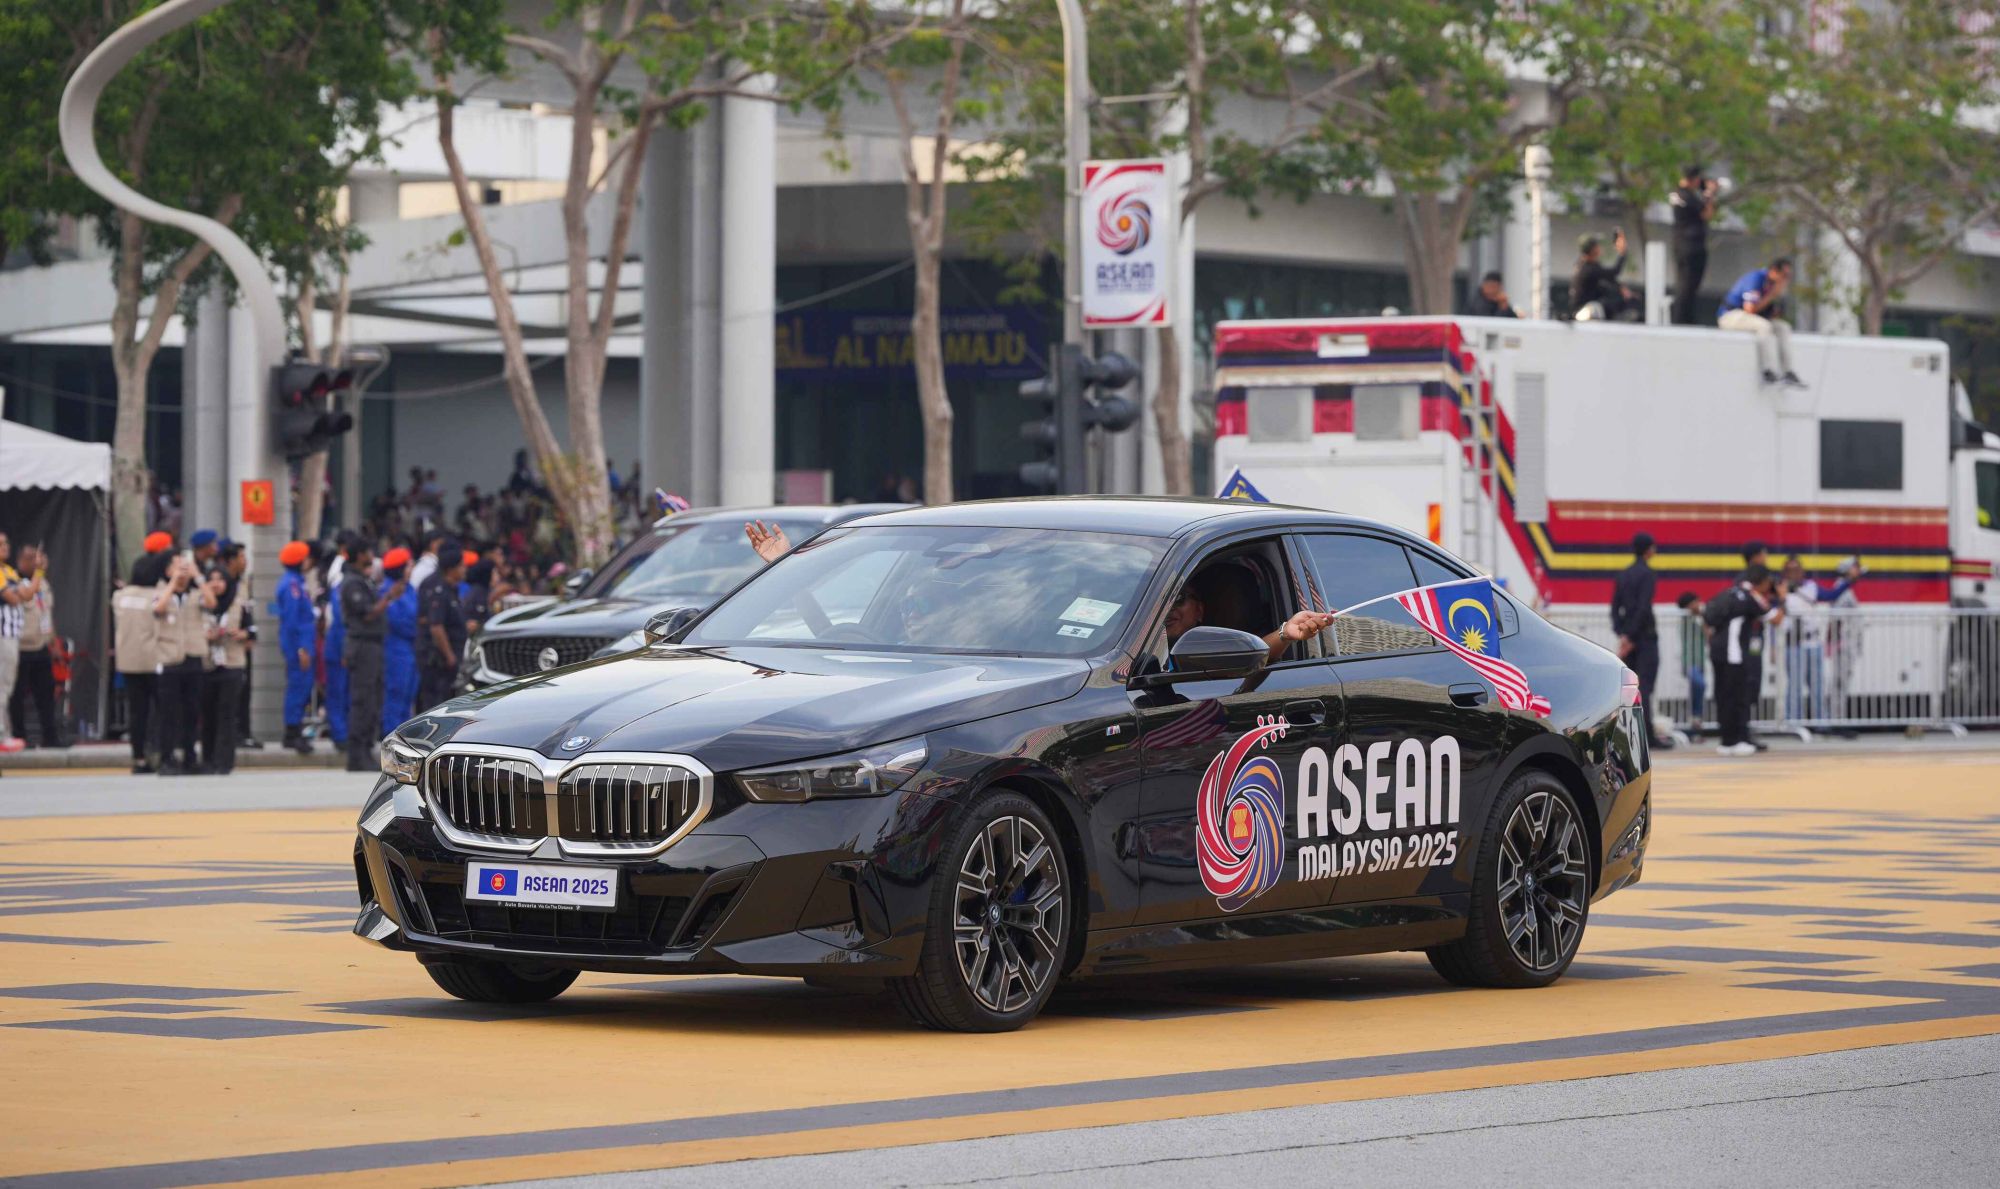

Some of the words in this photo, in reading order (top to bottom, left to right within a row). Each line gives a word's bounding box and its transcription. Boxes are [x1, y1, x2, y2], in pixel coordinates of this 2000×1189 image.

[1096, 262, 1154, 281] ASEAN
[833, 335, 872, 368] AL
[945, 332, 1025, 366] MAJU
[1296, 735, 1461, 839] ASEAN
[1298, 835, 1403, 882] MALAYSIA
[1402, 831, 1458, 869] 2025
[523, 875, 568, 893] ASEAN
[572, 878, 609, 896] 2025
